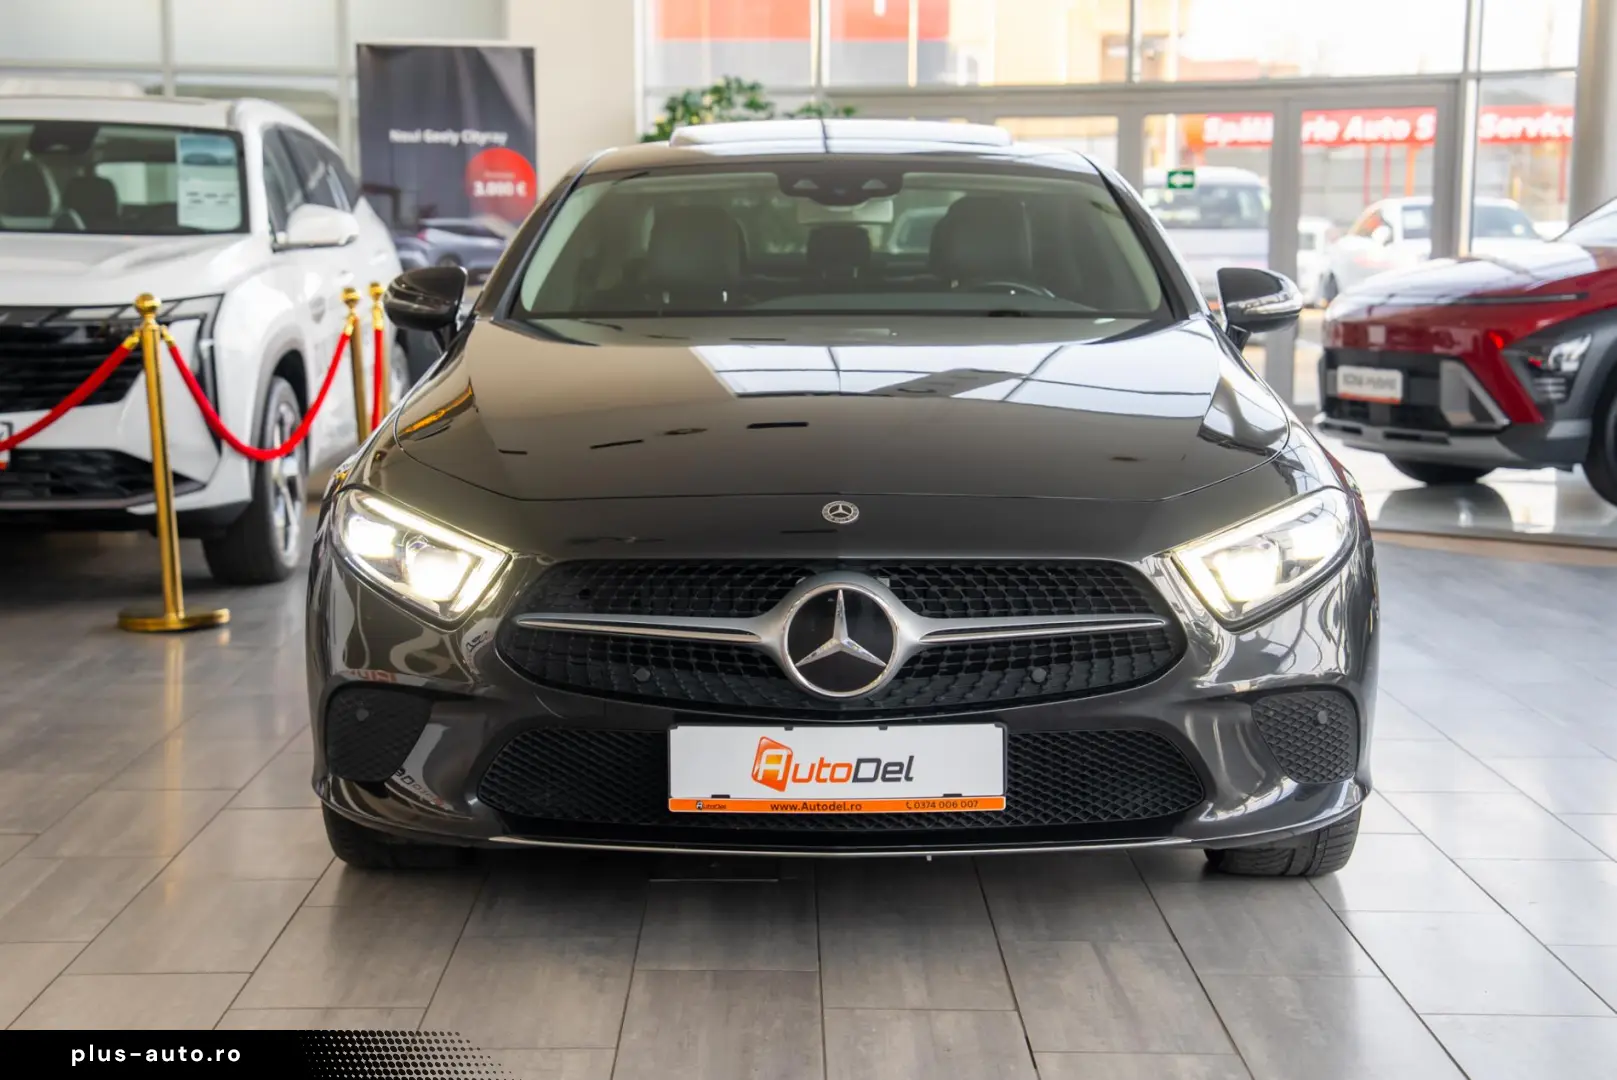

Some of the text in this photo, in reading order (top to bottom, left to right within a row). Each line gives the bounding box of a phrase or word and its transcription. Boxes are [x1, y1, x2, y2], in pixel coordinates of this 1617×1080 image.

[423, 128, 460, 147] Geely
[1343, 115, 1411, 142] Auto
[754, 745, 915, 786] AutoDel
[770, 801, 862, 812] www.Autodel.ro
[913, 801, 937, 810] 0374
[938, 800, 959, 810] 006
[960, 799, 979, 809] 007
